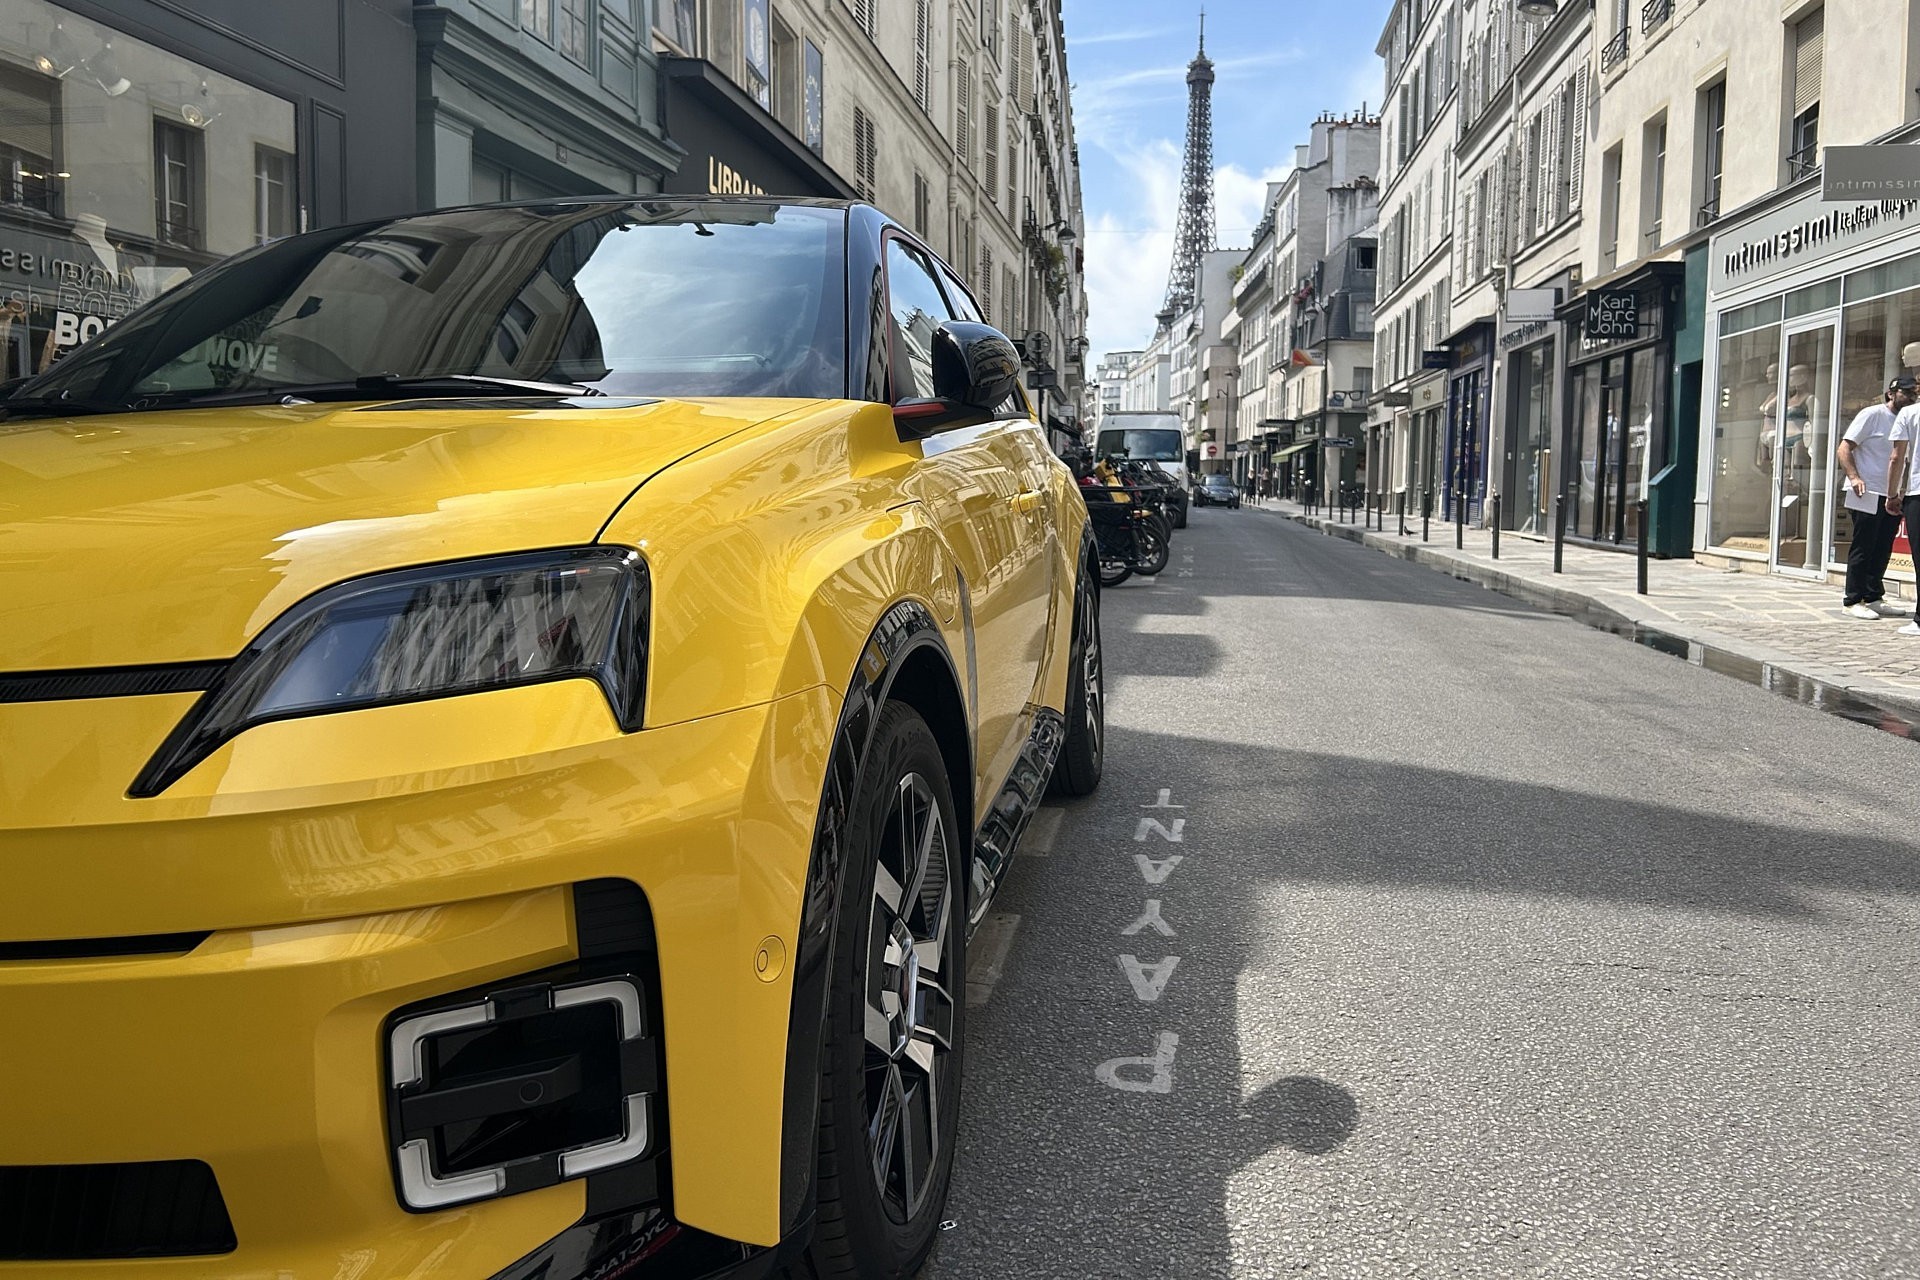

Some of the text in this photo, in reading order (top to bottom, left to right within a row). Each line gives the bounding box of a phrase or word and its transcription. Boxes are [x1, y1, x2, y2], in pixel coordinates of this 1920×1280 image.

[1599, 293, 1637, 310] Karl
[1590, 306, 1635, 322] Marc
[1590, 319, 1634, 335] John
[204, 336, 279, 372] MOVE
[1093, 788, 1186, 1093] PAYANT
